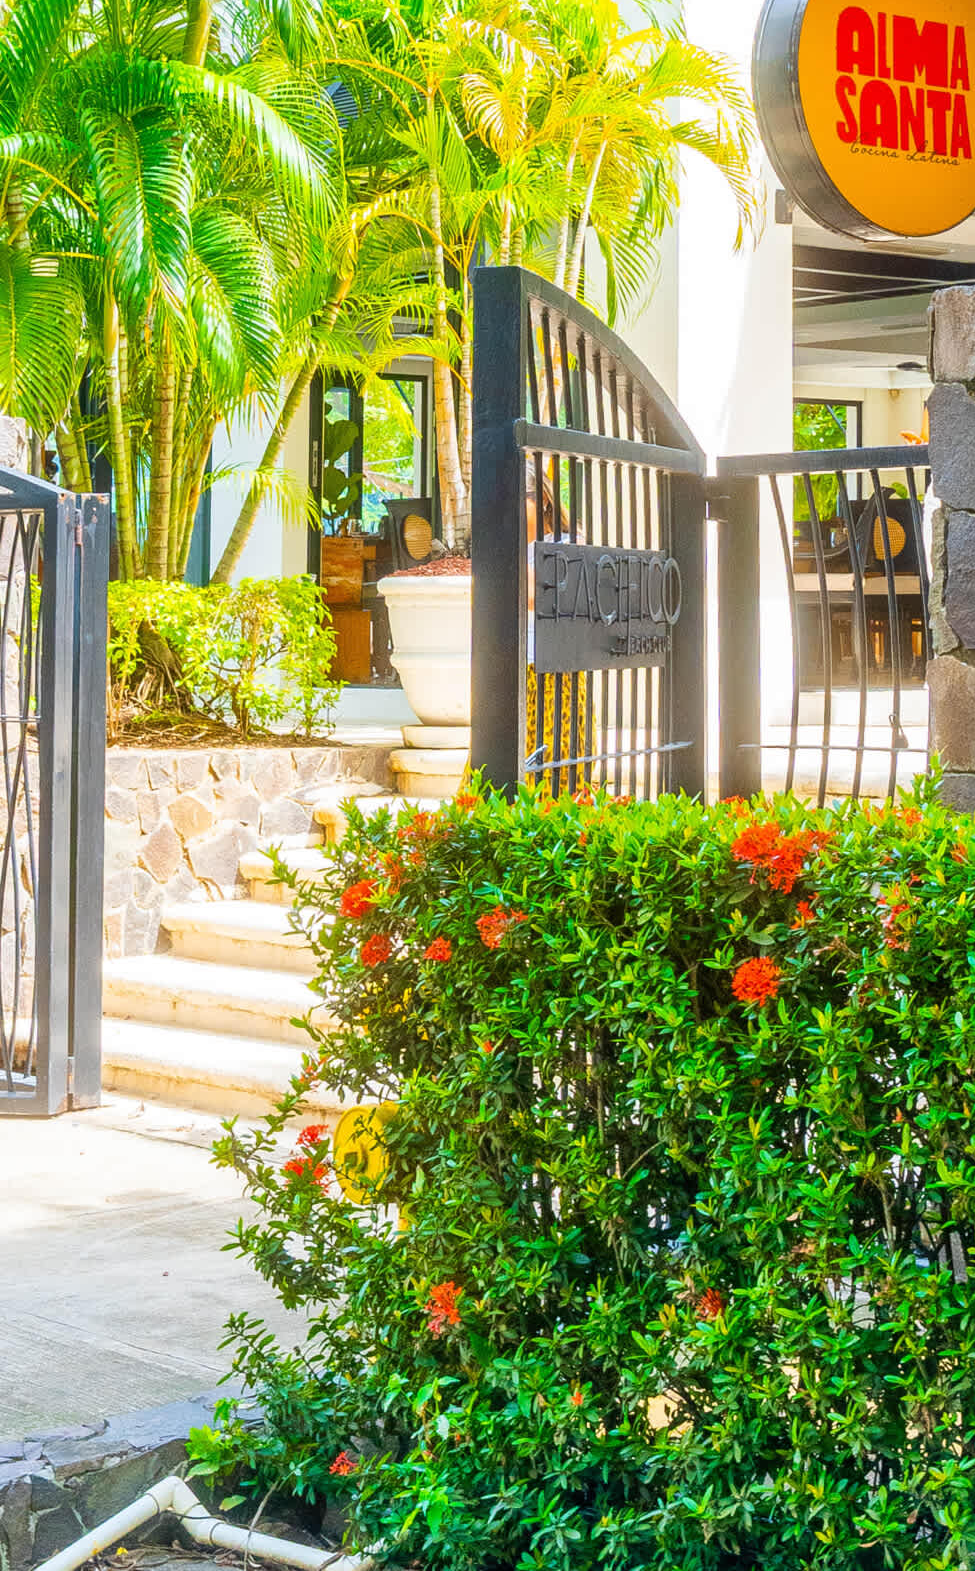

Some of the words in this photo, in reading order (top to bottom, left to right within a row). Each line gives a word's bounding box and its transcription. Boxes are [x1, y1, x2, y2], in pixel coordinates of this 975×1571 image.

[836, 6, 970, 91] ALMA
[835, 75, 972, 159] SANTA
[849, 132, 899, 158] Cocina
[906, 139, 961, 166] Latina
